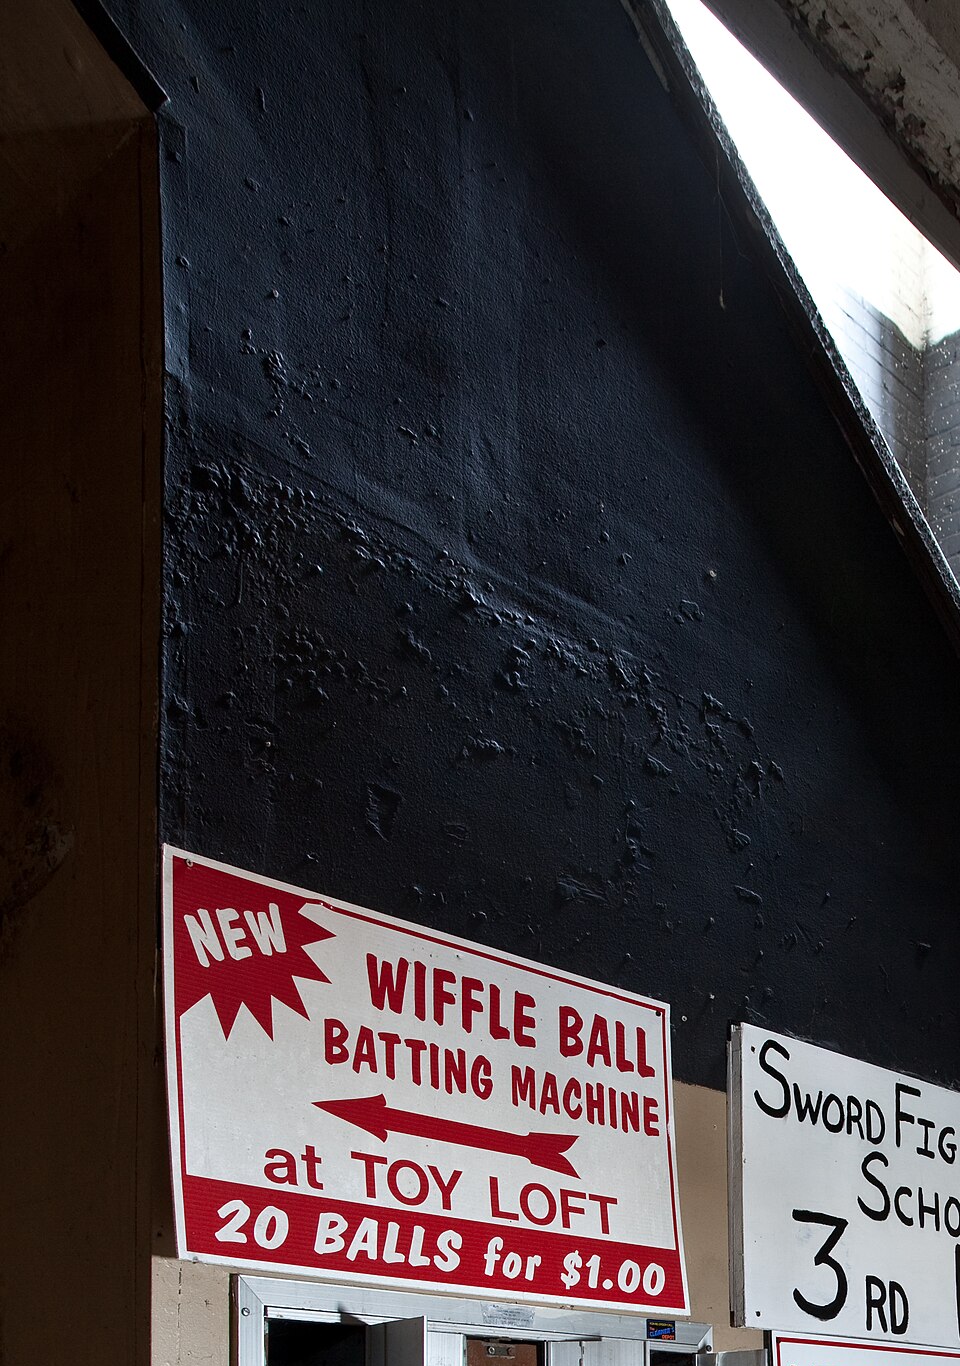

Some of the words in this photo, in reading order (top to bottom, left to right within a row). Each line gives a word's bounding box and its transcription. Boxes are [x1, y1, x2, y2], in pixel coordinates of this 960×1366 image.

[184, 903, 287, 968] NEW
[367, 953, 537, 1048] WIFFLE
[559, 1005, 656, 1078] BALL
[324, 1018, 493, 1100] BATTING
[511, 1065, 660, 1137] MACHINE
[754, 1040, 886, 1145] SWORD
[263, 1145, 324, 1190] at
[351, 1151, 463, 1211] TOY
[489, 1176, 618, 1235] LOFT
[214, 1200, 289, 1250] 20
[314, 1212, 463, 1273] BALLS
[484, 1237, 542, 1281] for
[561, 1250, 666, 1297] $1.00
